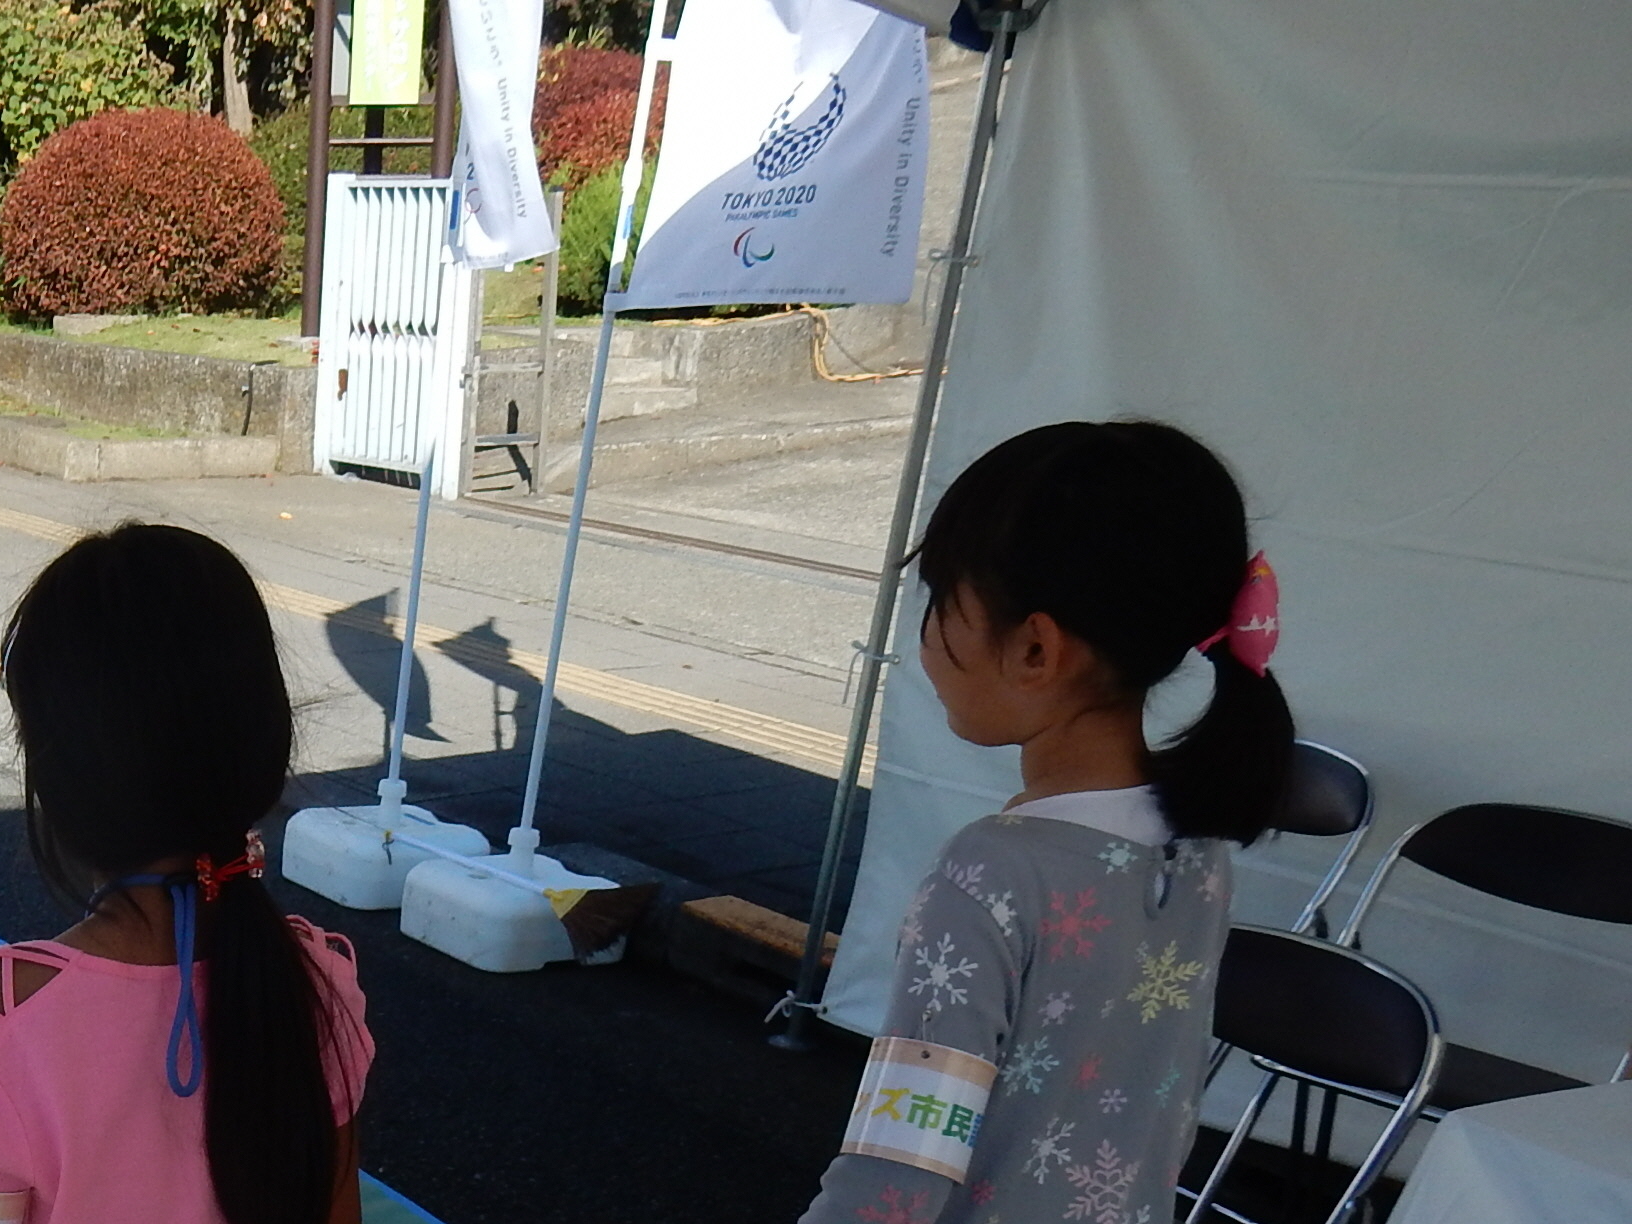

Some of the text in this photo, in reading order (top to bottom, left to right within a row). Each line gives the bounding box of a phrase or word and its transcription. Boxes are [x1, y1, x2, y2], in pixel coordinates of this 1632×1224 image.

[497, 77, 512, 124] Unity
[506, 146, 528, 219] Diversity
[721, 184, 818, 210] TOKYO 2020
[880, 97, 922, 257] Unity in Diversity
